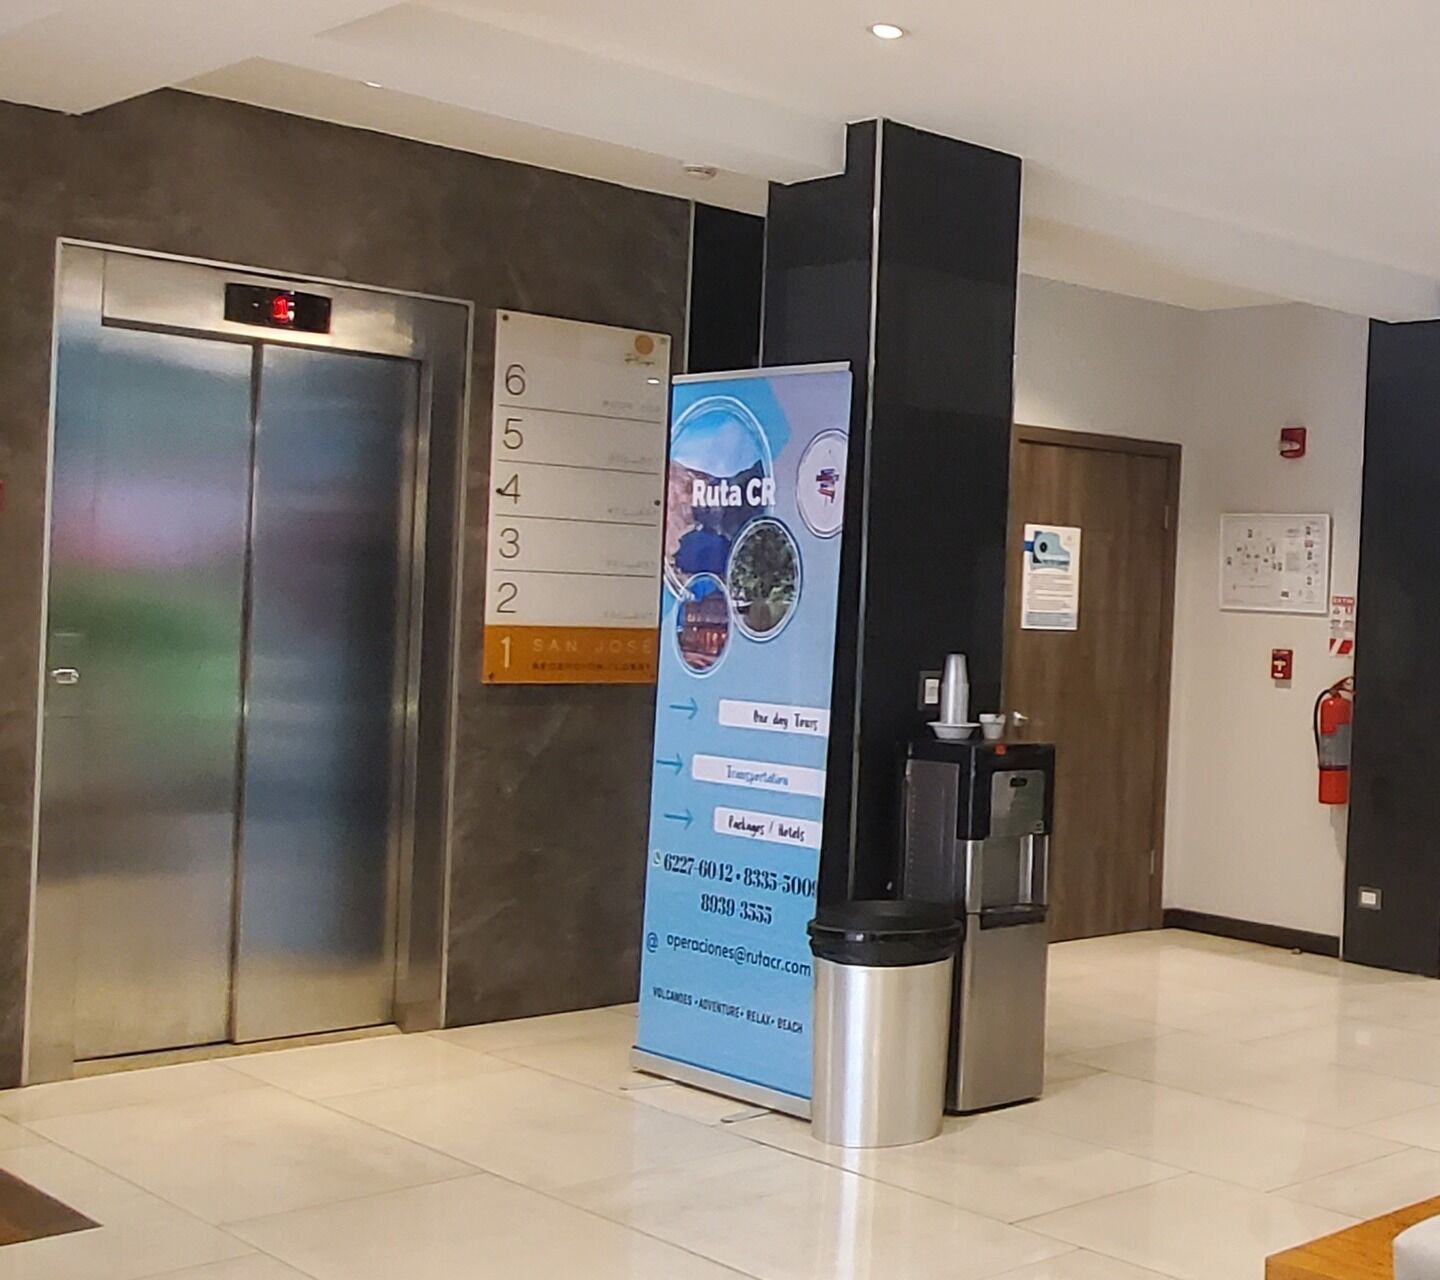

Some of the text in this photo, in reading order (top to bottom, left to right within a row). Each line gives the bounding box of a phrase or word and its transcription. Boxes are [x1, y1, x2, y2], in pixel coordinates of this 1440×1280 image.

[505, 364, 526, 396] 6
[503, 417, 524, 450] 5
[500, 473, 521, 504] 4
[692, 477, 776, 507] Ruta CR
[499, 527, 520, 559] 3
[496, 582, 518, 614] 2
[501, 636, 511, 668] 1
[532, 638, 578, 652] SAN
